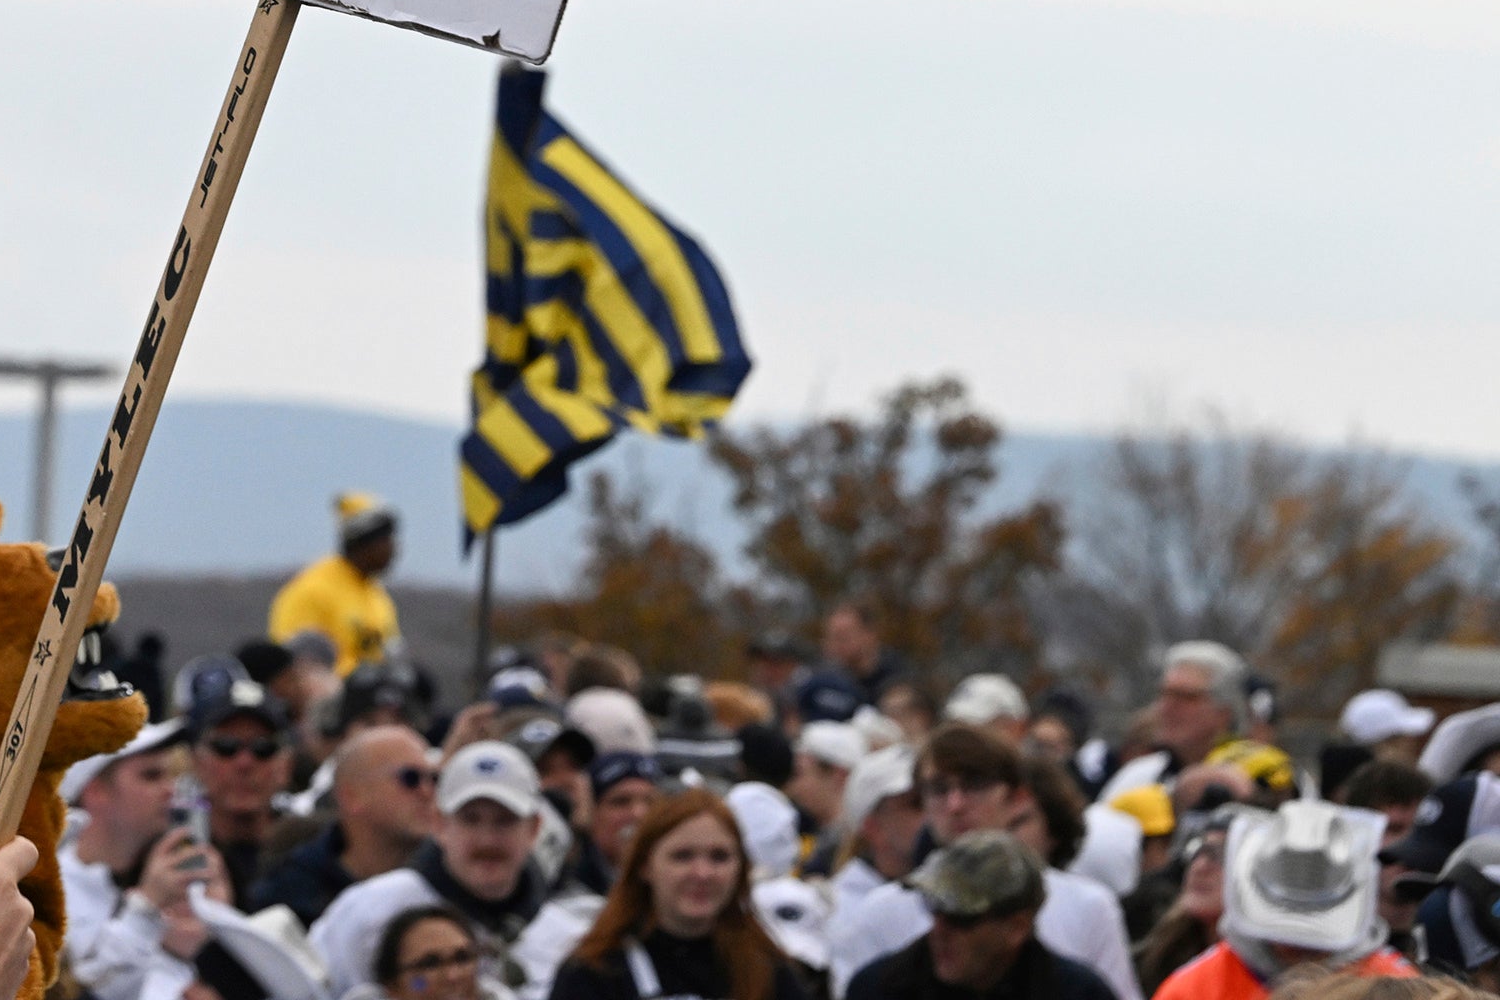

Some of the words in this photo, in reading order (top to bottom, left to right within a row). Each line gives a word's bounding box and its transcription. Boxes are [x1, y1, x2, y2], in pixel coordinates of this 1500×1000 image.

[200, 46, 257, 209] JET-FLO
[51, 224, 192, 625] MYLEC
[6, 719, 24, 762] 307
